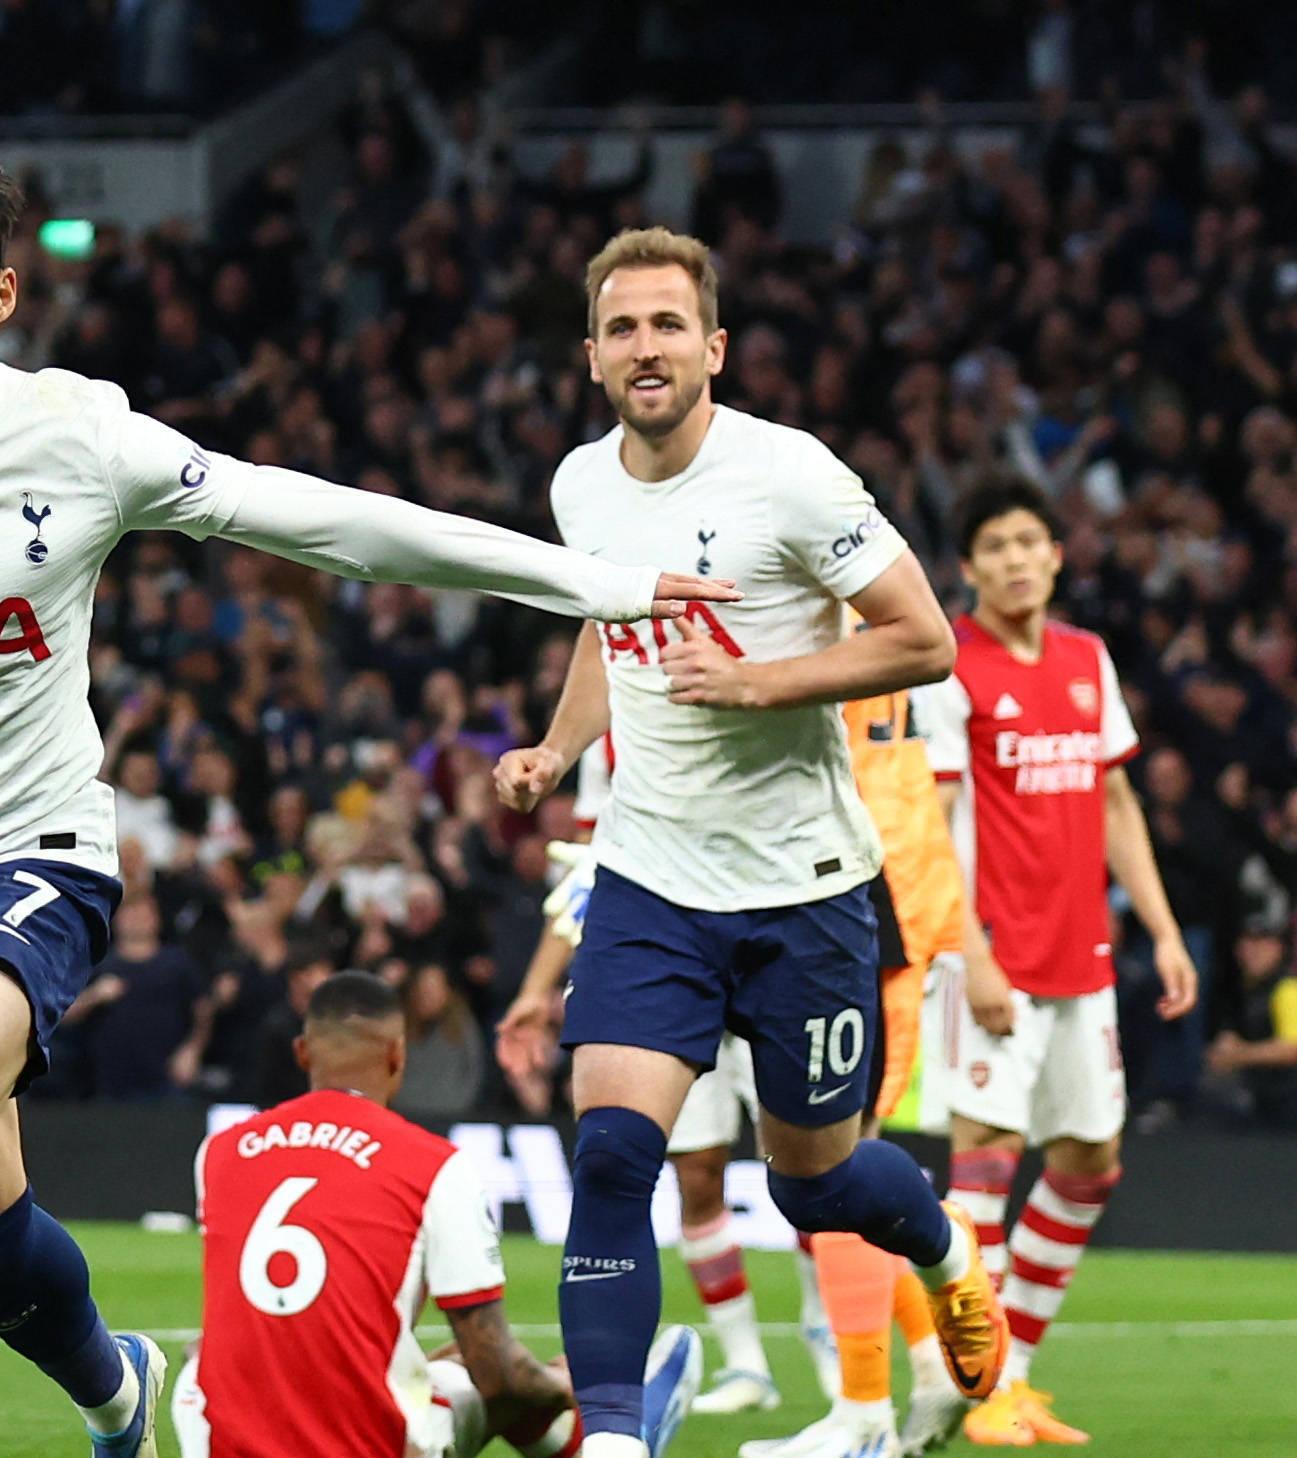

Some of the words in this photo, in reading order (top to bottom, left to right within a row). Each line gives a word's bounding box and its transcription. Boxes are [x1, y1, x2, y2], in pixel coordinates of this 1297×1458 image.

[2, 869, 62, 929] 7
[805, 1007, 865, 1083] 10
[237, 1121, 383, 1169] GABRIEL
[238, 1176, 329, 1317] 6
[563, 1255, 637, 1272] SPURS
